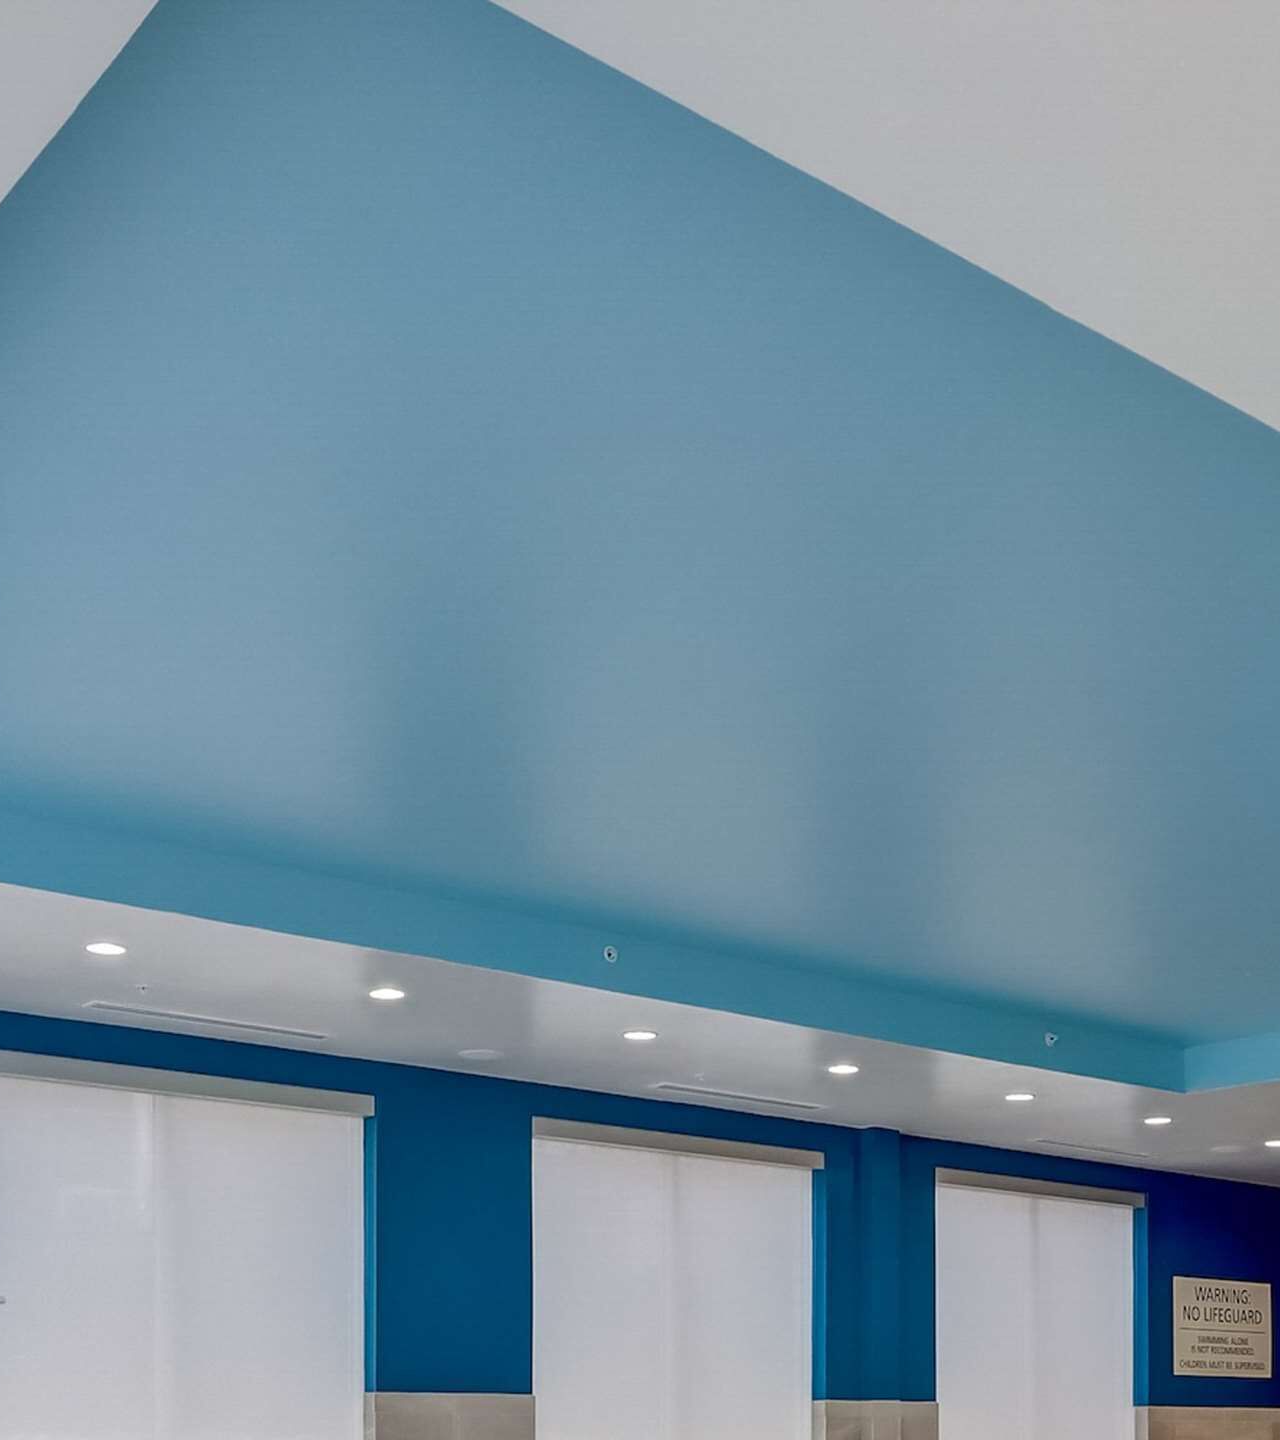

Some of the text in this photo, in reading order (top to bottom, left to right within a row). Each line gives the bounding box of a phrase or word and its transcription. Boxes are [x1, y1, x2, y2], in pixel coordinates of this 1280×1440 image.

[1194, 1286, 1252, 1306] WARNING:
[1183, 1305, 1263, 1325] NO LIFEGUARD
[1197, 1345, 1210, 1354] NOT
[1208, 1360, 1225, 1369] MUST
